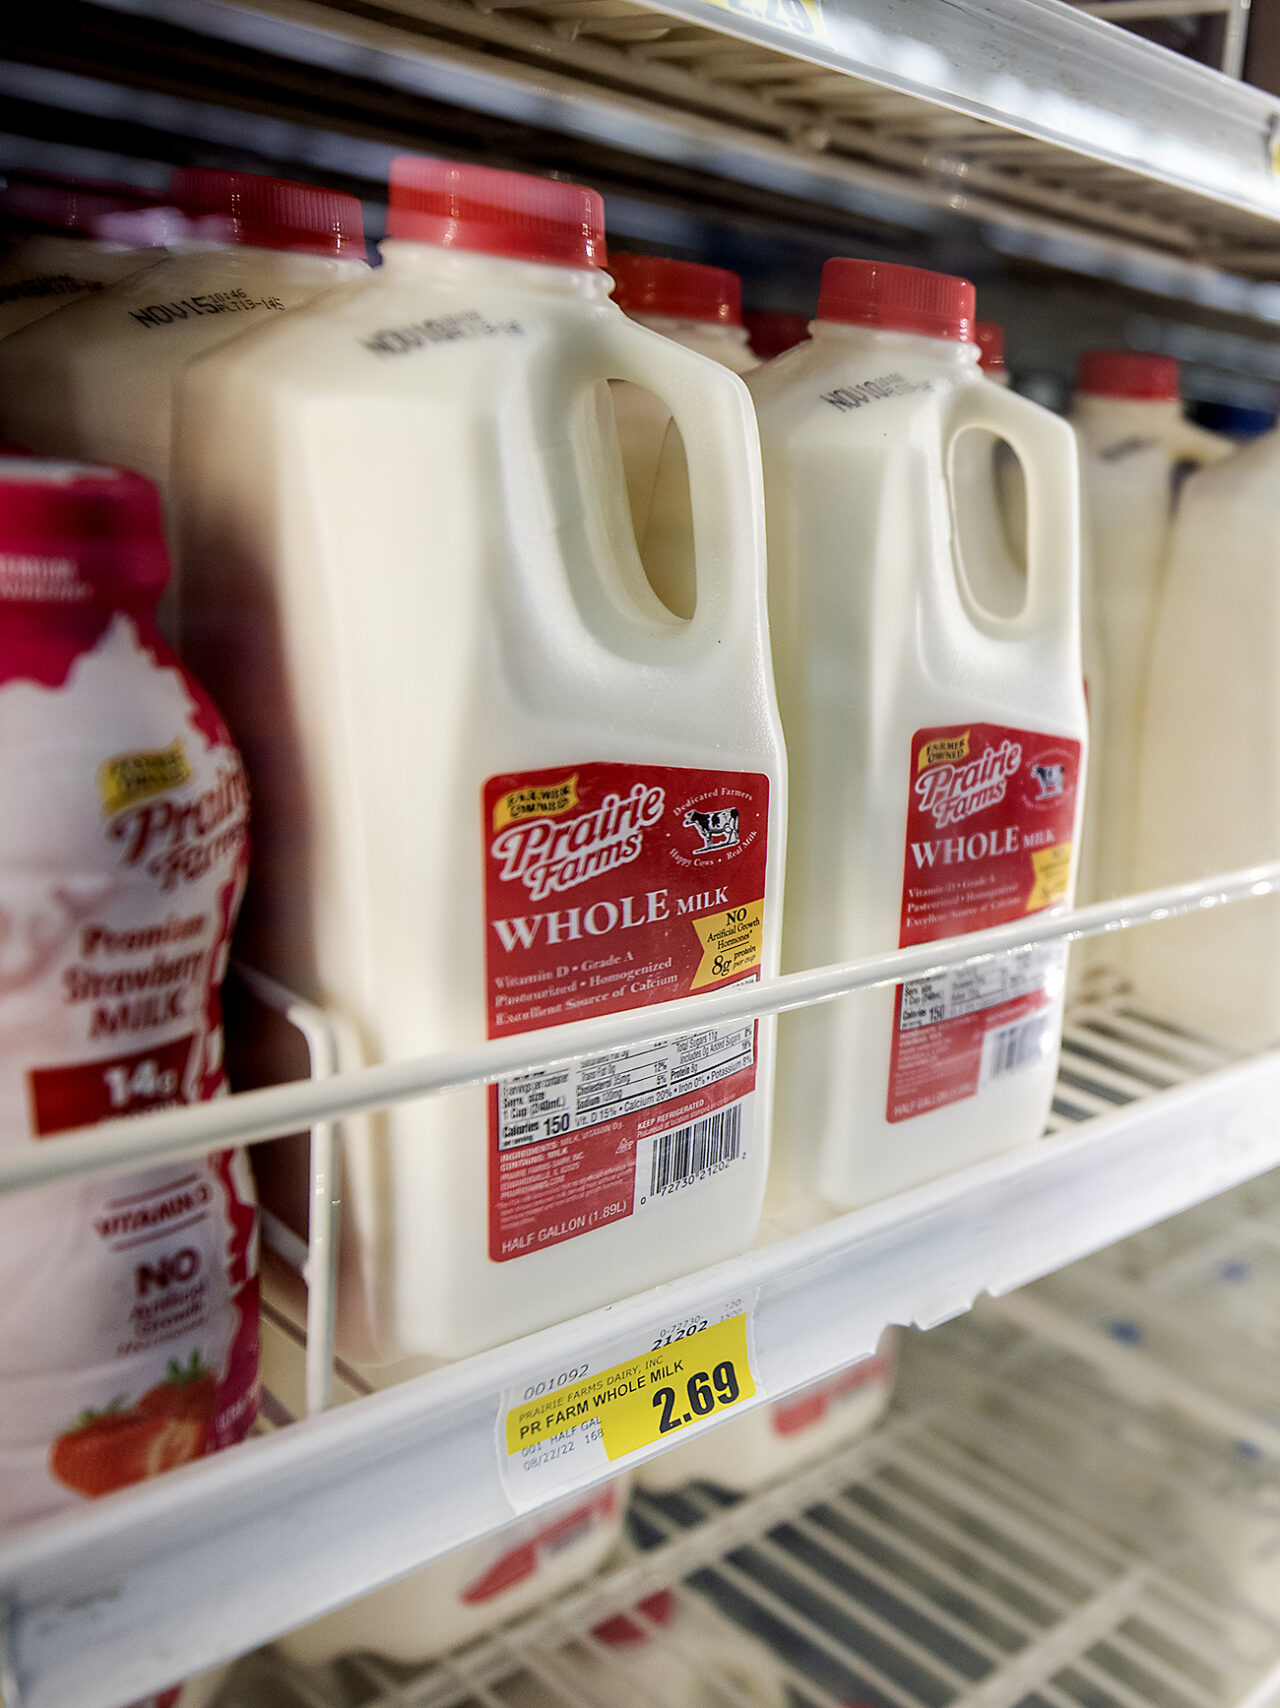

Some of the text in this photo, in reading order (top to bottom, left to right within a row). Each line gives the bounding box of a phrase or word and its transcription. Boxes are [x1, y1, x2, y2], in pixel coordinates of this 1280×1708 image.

[926, 738, 965, 754] FARMER
[928, 748, 964, 763] OWNED
[915, 740, 1022, 811] Prairie
[673, 787, 753, 816] Dedicated Farmers
[932, 779, 1007, 829] Farms
[491, 783, 666, 882] Prairie
[669, 831, 758, 868] Happy Cows Real Milk
[911, 826, 1056, 869] WHOLE MILK
[522, 832, 644, 901] Farms
[492, 886, 729, 952] WHOLE MILK
[707, 917, 760, 943] Artificial Growth
[726, 908, 748, 926] NO
[495, 951, 634, 989] Vitamin D Grade A
[589, 957, 673, 988] Homogenized
[712, 955, 732, 976] 8g
[564, 992, 610, 1011] Source
[611, 984, 627, 998] of
[630, 974, 678, 994] Calcium
[89, 985, 187, 1042] MILK
[690, 1034, 708, 1049] Sugars
[591, 1113, 598, 1123] D
[624, 1095, 655, 1112] Calcium
[655, 1088, 672, 1101] 20%
[678, 1081, 693, 1094] Iron
[694, 1077, 706, 1088] 0%
[711, 1061, 742, 1081] Potassium
[504, 1113, 570, 1138] Calories 150
[637, 1099, 705, 1130] KEEP REFRIGERATED
[640, 1196, 647, 1205] 0
[661, 1175, 695, 1197] 72730
[699, 1160, 730, 1180] 21202
[501, 1201, 627, 1254] HALF GALLON (1.89L)
[135, 1249, 200, 1298] NO
[651, 1320, 708, 1352] 21202
[519, 1355, 663, 1423] PRAIRIE FARMS DAIRY, INC
[520, 1360, 684, 1440] PR FARM WHOLE MILK
[523, 1364, 590, 1400] 001092
[652, 1361, 740, 1434] 2.69
[550, 1425, 578, 1445] HALF
[523, 1441, 576, 1472] 08/22/22
